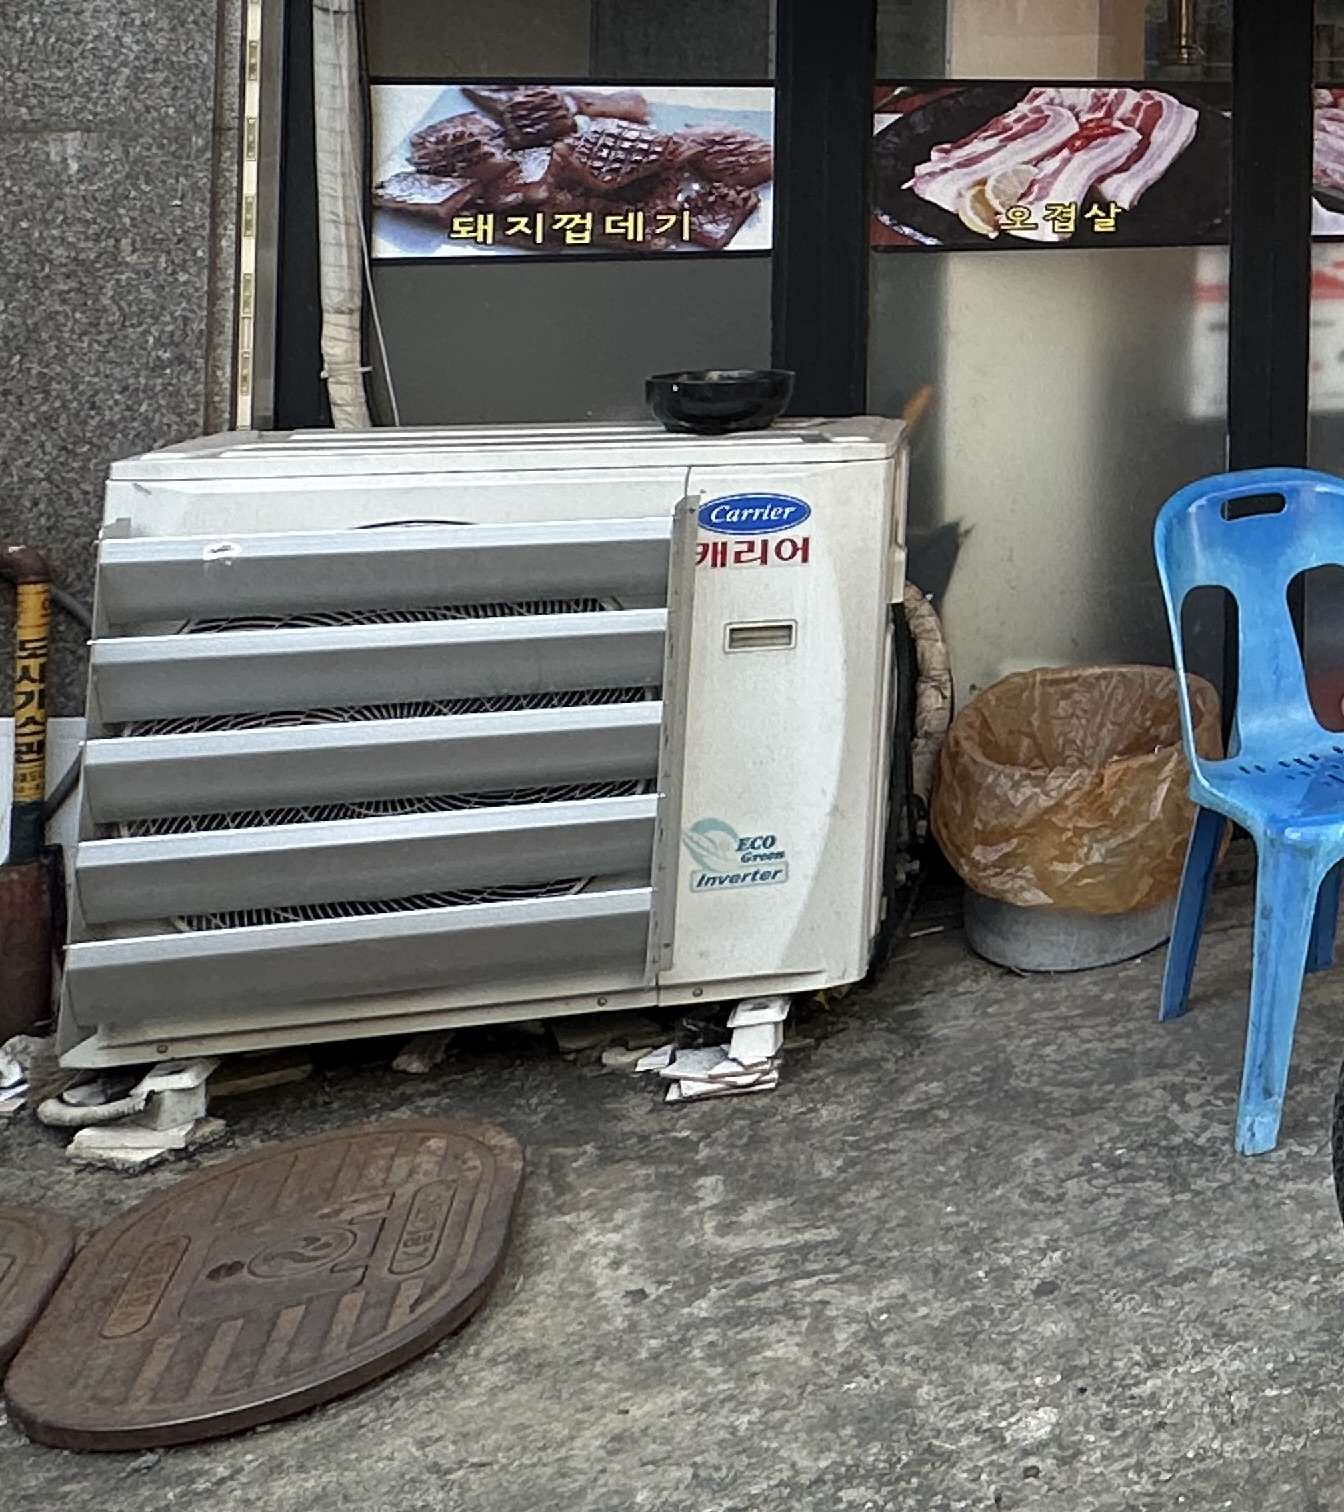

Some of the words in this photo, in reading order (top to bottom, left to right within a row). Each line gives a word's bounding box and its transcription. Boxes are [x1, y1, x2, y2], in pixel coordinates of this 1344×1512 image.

[449, 210, 692, 245] 돼지껍데기
[999, 201, 1123, 233] 오겹살
[709, 501, 797, 525] Carrier
[695, 537, 811, 569] 캐리어
[736, 833, 777, 854] ECO
[740, 848, 786, 864] Green
[695, 864, 783, 889] Inverter
